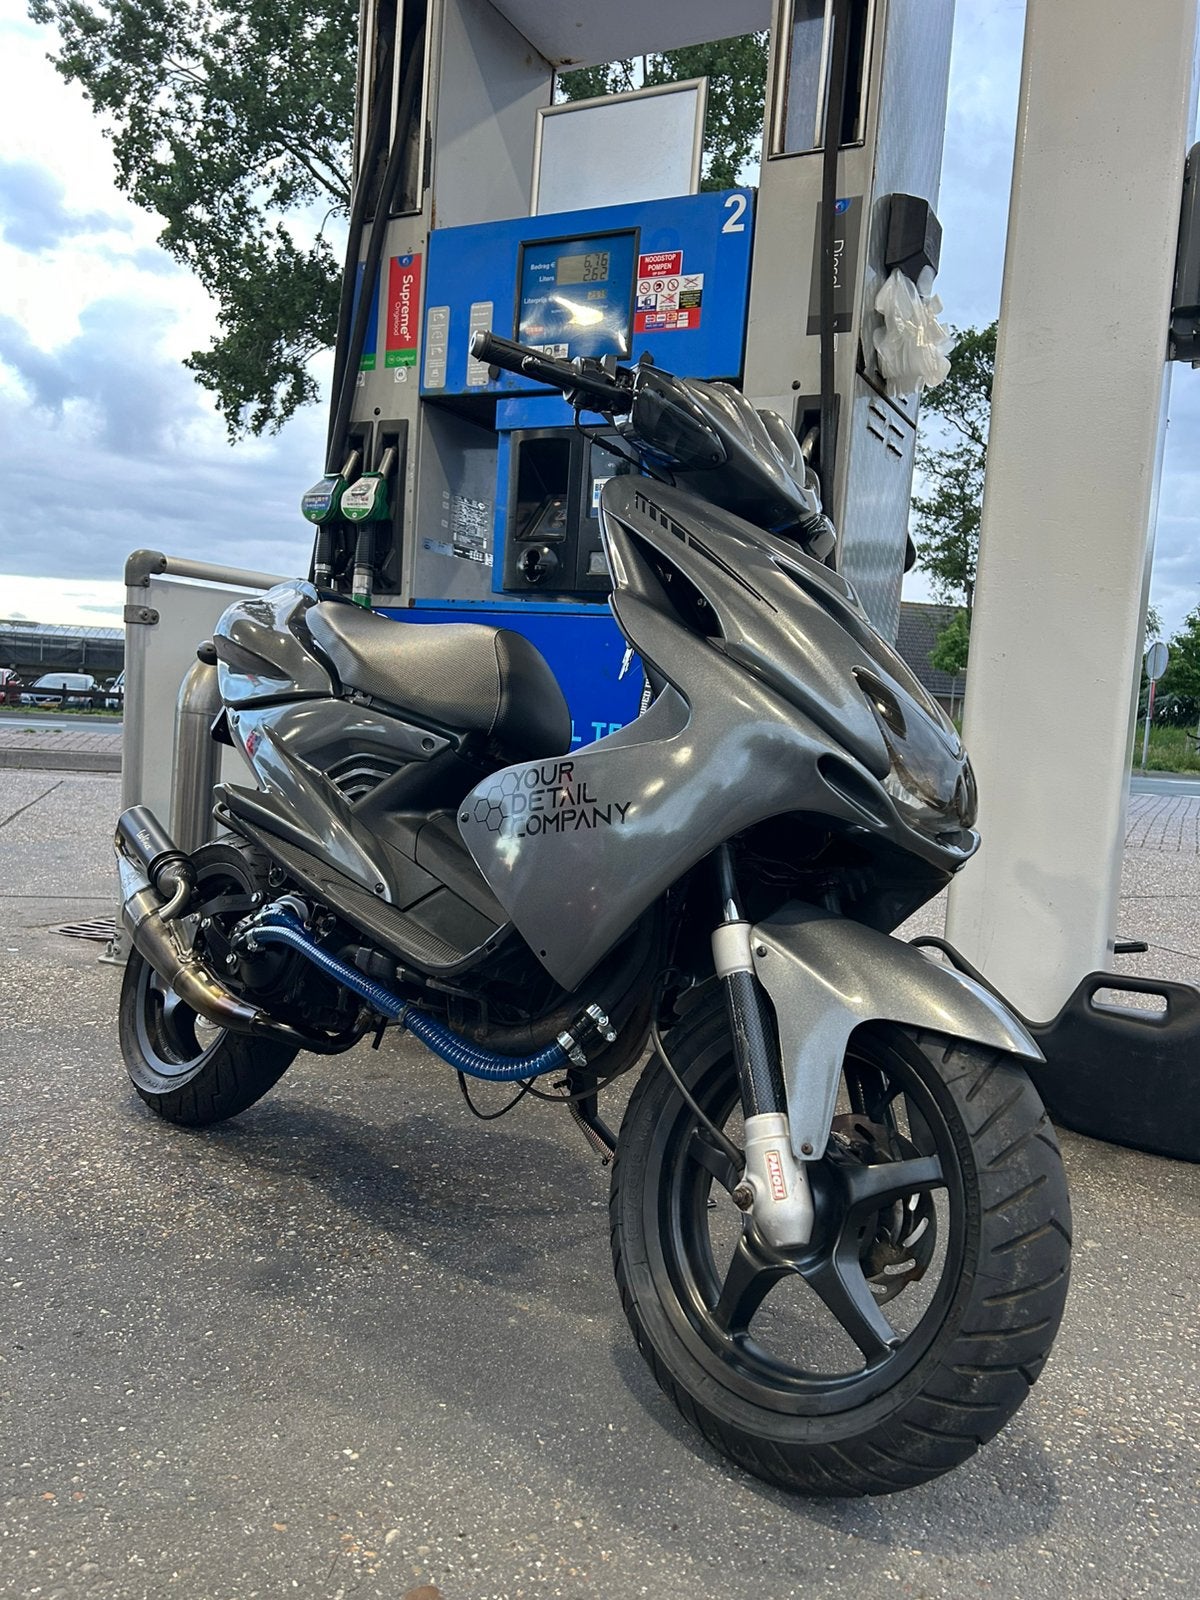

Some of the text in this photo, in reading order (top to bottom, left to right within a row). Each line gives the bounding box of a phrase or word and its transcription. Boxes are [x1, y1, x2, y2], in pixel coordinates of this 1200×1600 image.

[722, 194, 747, 234] 2
[645, 254, 676, 263] NOODSTOP
[648, 263, 672, 271] POMPEN
[400, 275, 413, 342] Supreme+
[513, 762, 574, 791] YOUR
[511, 782, 597, 814] DETAIL
[511, 802, 632, 838] COMPANY
[767, 1153, 785, 1198] PAIOLI
